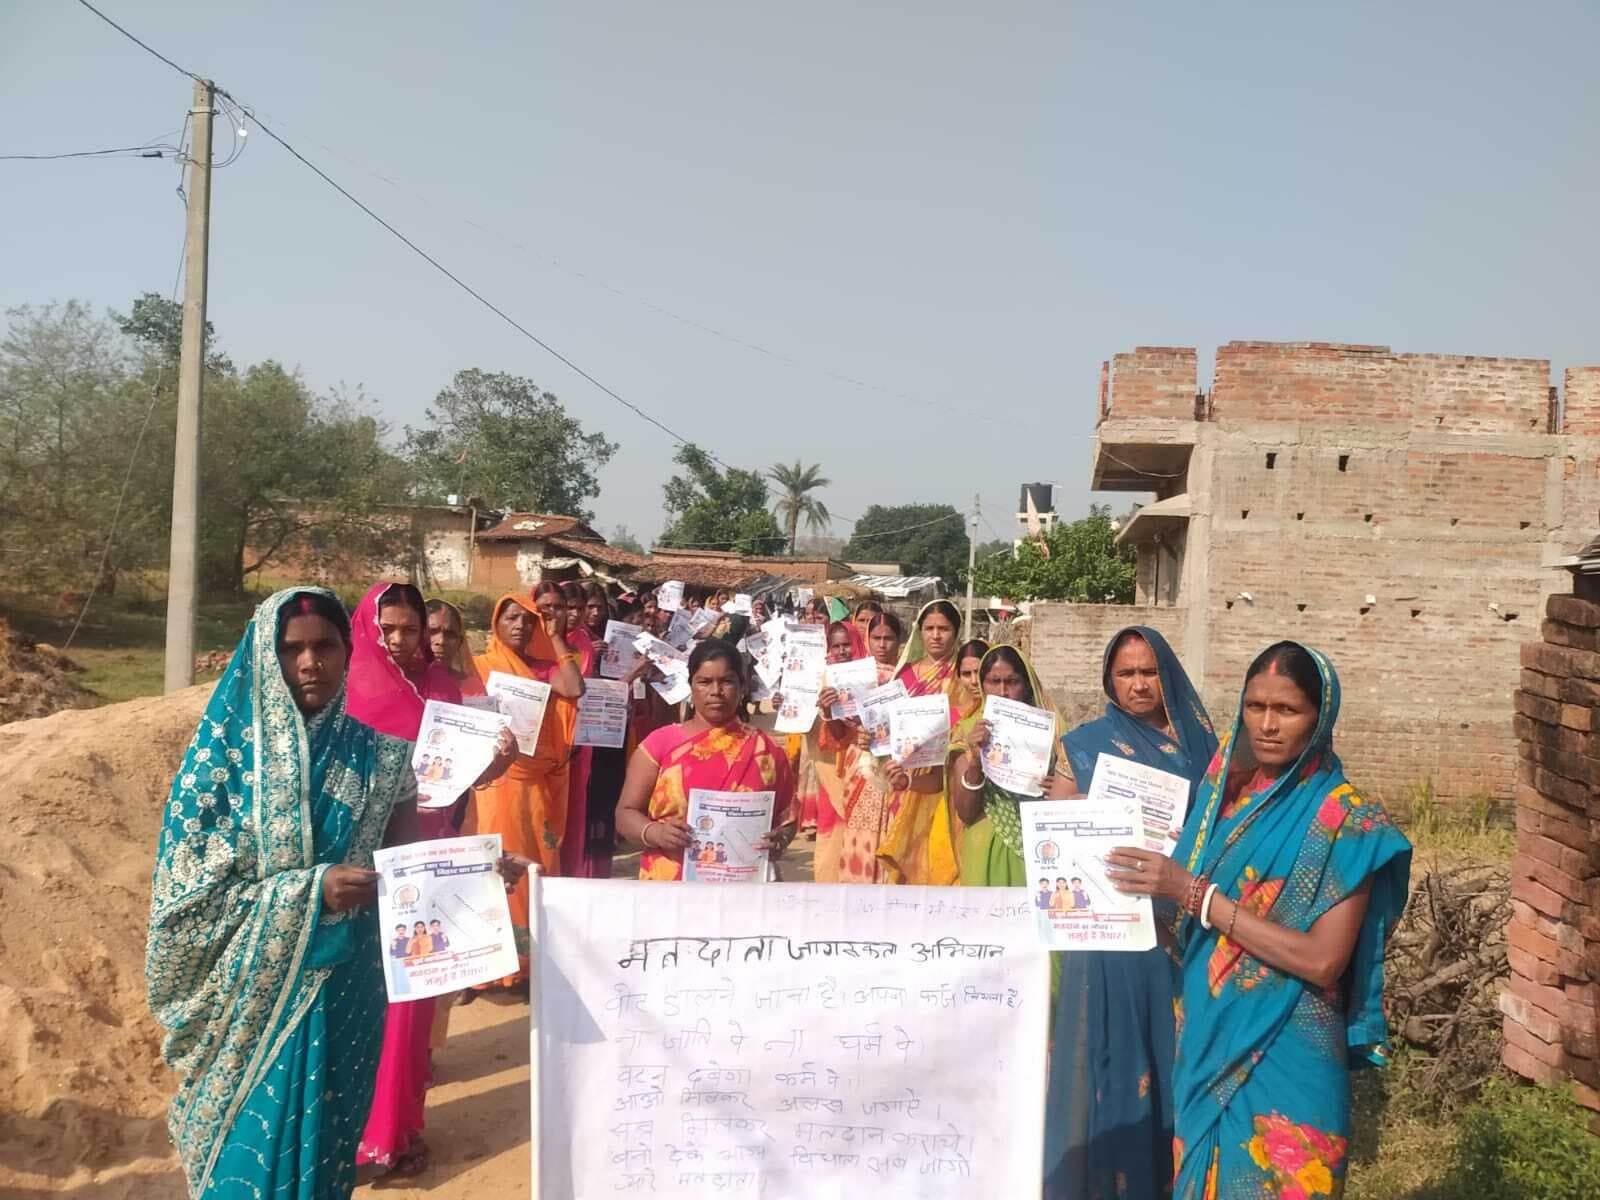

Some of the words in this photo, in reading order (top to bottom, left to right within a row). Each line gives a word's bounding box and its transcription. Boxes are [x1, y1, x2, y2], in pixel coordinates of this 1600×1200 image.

[617, 935, 787, 972] मतदाता
[911, 936, 1005, 962] अभियान
[664, 976, 736, 1016] डालने
